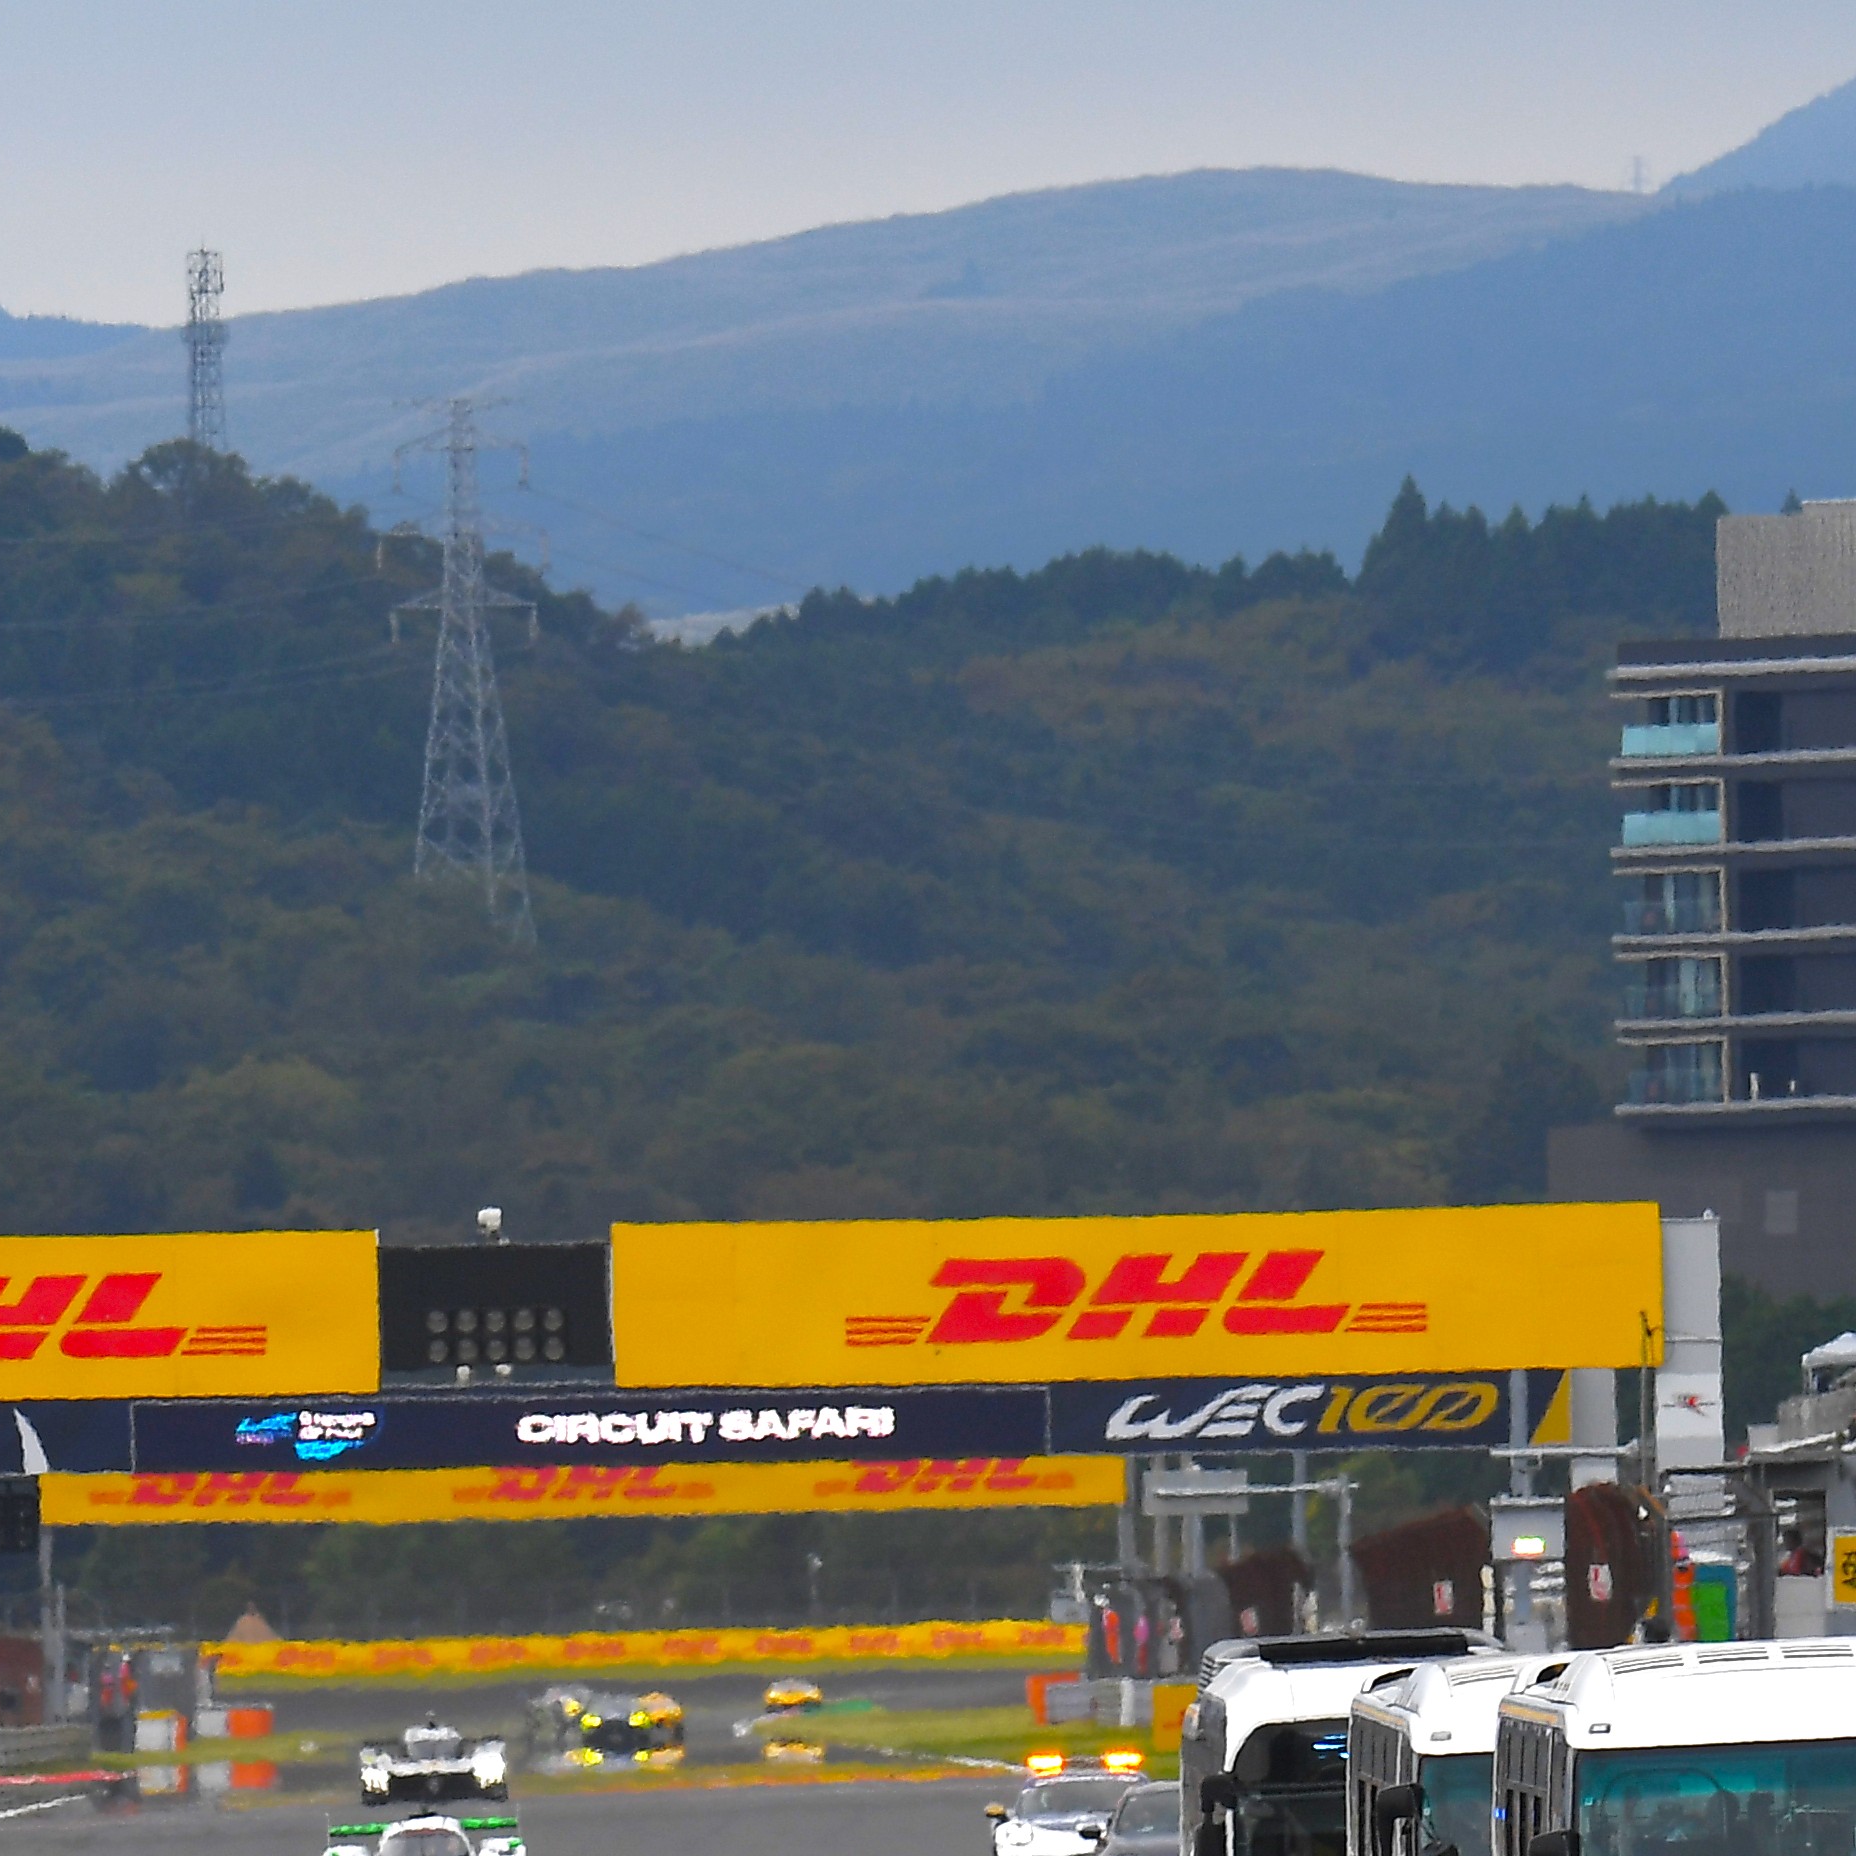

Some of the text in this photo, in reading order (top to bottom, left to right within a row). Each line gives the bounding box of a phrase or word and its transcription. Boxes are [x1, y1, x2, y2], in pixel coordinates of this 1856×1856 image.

[925, 1249, 1351, 1344] DHL
[516, 1406, 897, 1444] CIRCUIT SAFARI
